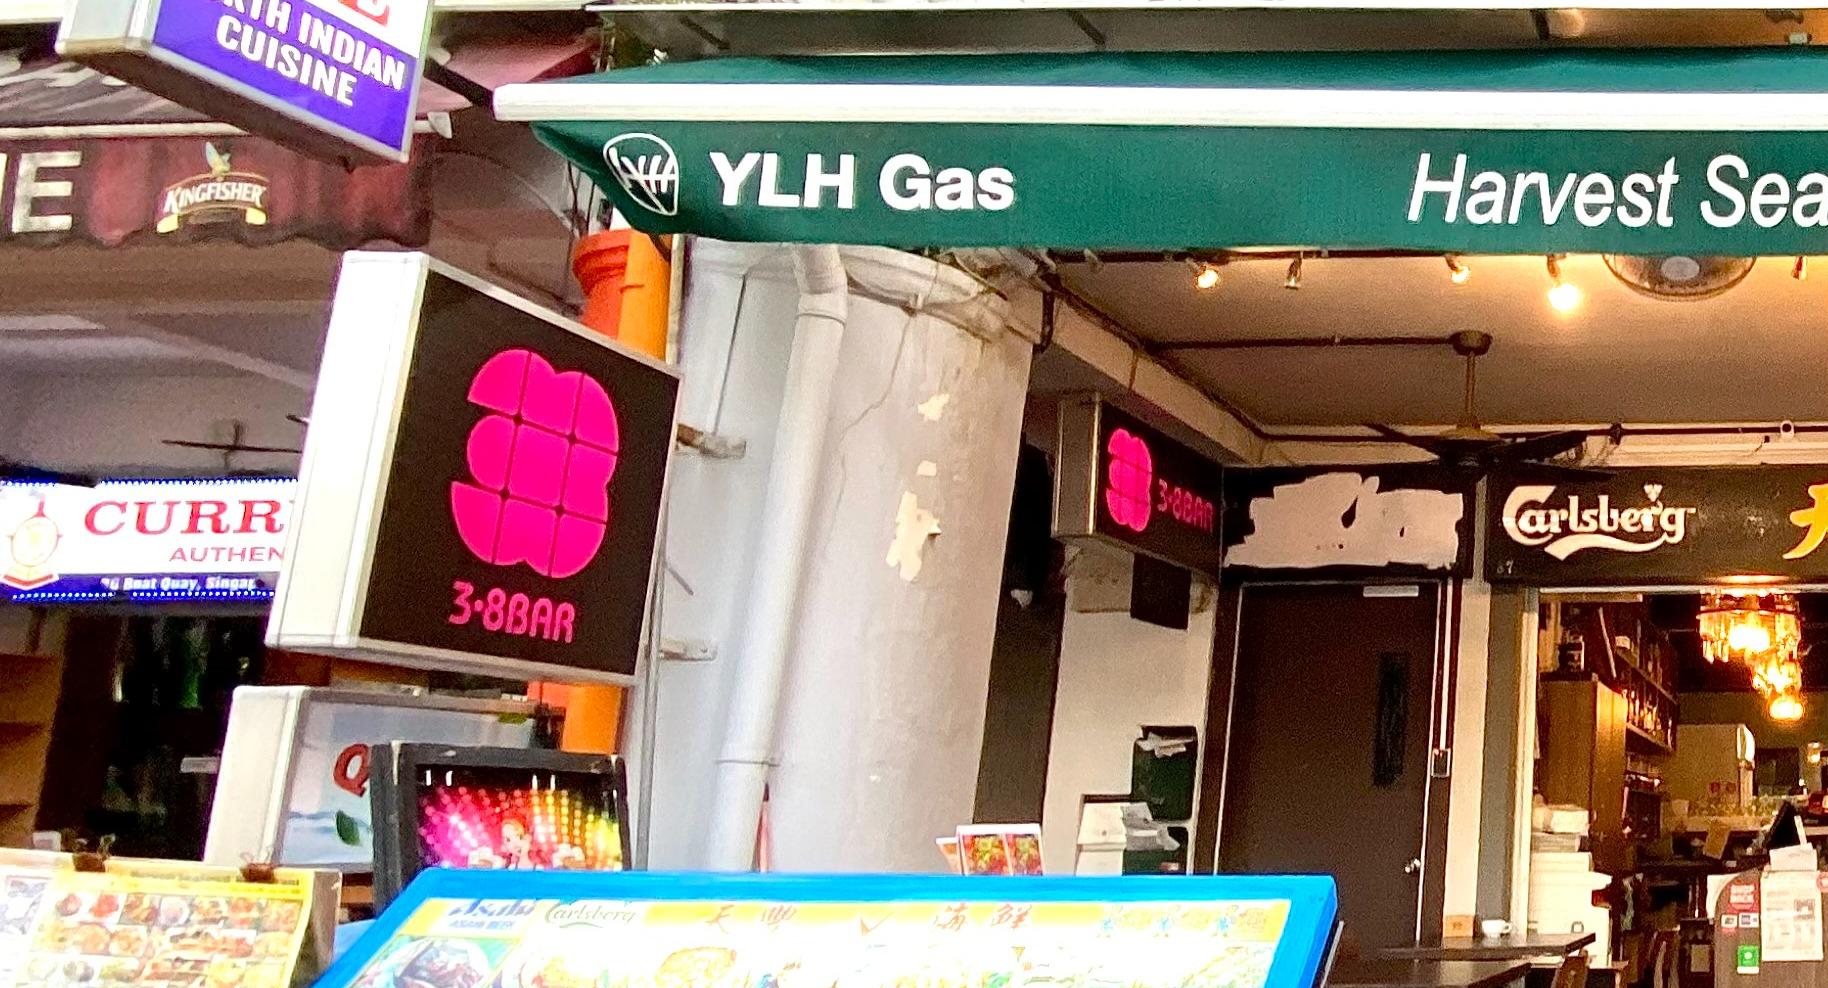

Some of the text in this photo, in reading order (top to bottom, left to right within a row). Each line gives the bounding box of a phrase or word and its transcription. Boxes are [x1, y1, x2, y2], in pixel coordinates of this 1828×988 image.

[216, 14, 358, 107] CUISINE
[299, 12, 406, 91] INDIAN
[163, 181, 267, 214] KINGFISHER
[709, 152, 1016, 211] YLH Gas
[1406, 152, 1680, 228] Harvest
[84, 499, 297, 536] CURR
[1501, 483, 1697, 561] Carlsberg
